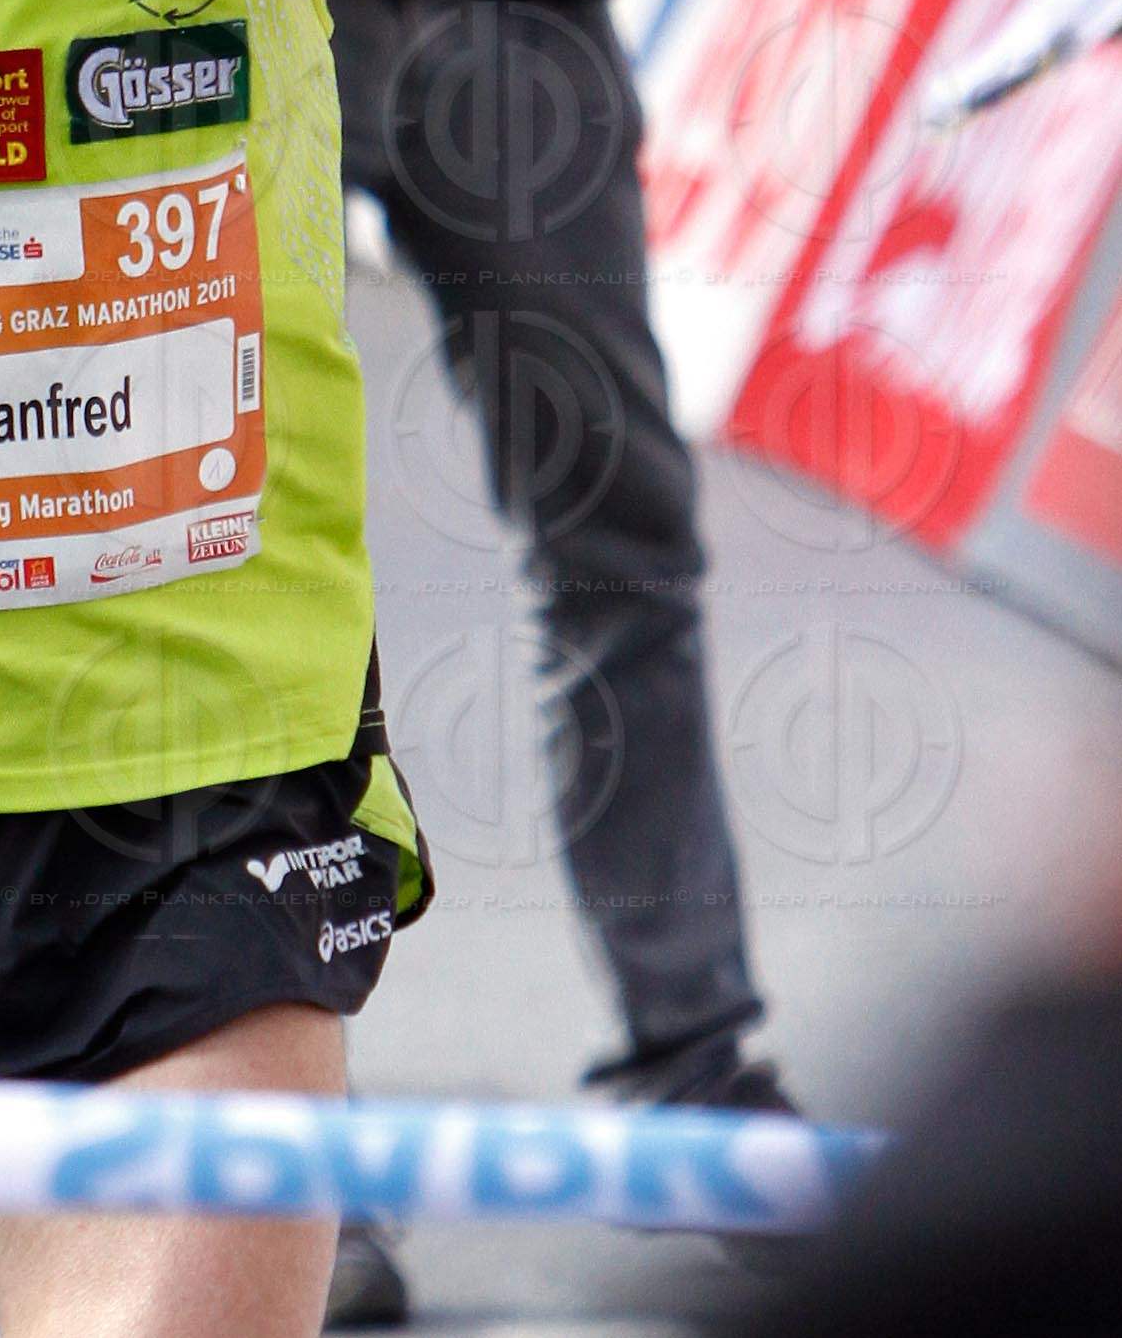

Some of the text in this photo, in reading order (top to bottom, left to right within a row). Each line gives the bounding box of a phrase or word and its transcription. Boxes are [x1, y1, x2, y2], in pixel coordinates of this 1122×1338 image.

[0, 107, 16, 121] of
[78, 46, 241, 128] Gösser
[116, 181, 229, 278] 397
[9, 305, 69, 334] GRAZ
[78, 286, 190, 327] MARATHON
[196, 274, 236, 305] 2011
[19, 487, 134, 520] Marathon
